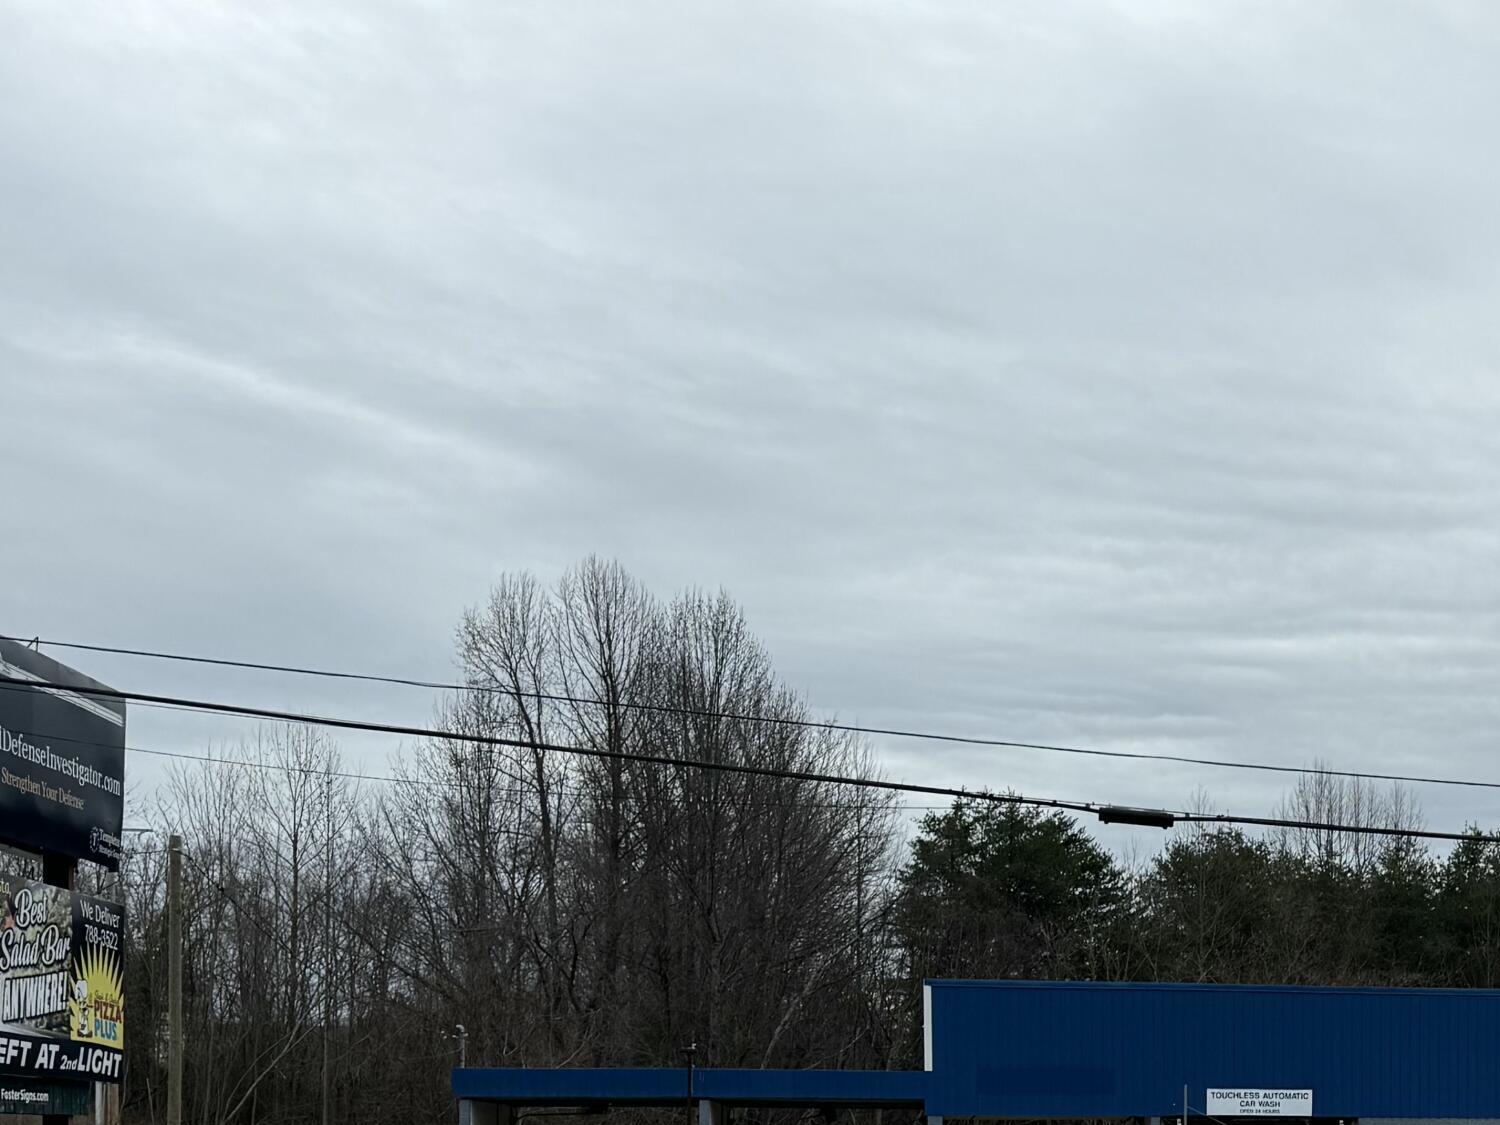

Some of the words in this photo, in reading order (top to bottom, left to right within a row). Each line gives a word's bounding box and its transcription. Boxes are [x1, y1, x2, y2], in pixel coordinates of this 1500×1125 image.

[1, 766, 41, 797] Strengthen
[41, 781, 58, 802] Your
[58, 787, 86, 811] Defense
[14, 888, 48, 928] Best
[79, 900, 94, 920] We
[95, 905, 120, 928] Deliver
[0, 928, 40, 972] Salad
[40, 925, 71, 967] Bar
[84, 924, 119, 951] 788-3522
[2, 971, 68, 1022] ANYWHERE!
[94, 1000, 122, 1024] PIZZA
[94, 1018, 117, 1041] PLUS
[34, 1043, 60, 1069] AT
[59, 1054, 78, 1071] 2nd
[77, 1046, 122, 1079] LIGHT
[0, 1087, 49, 1104] FosterSigns.com
[1262, 1092, 1309, 1100] AUTOMATIC
